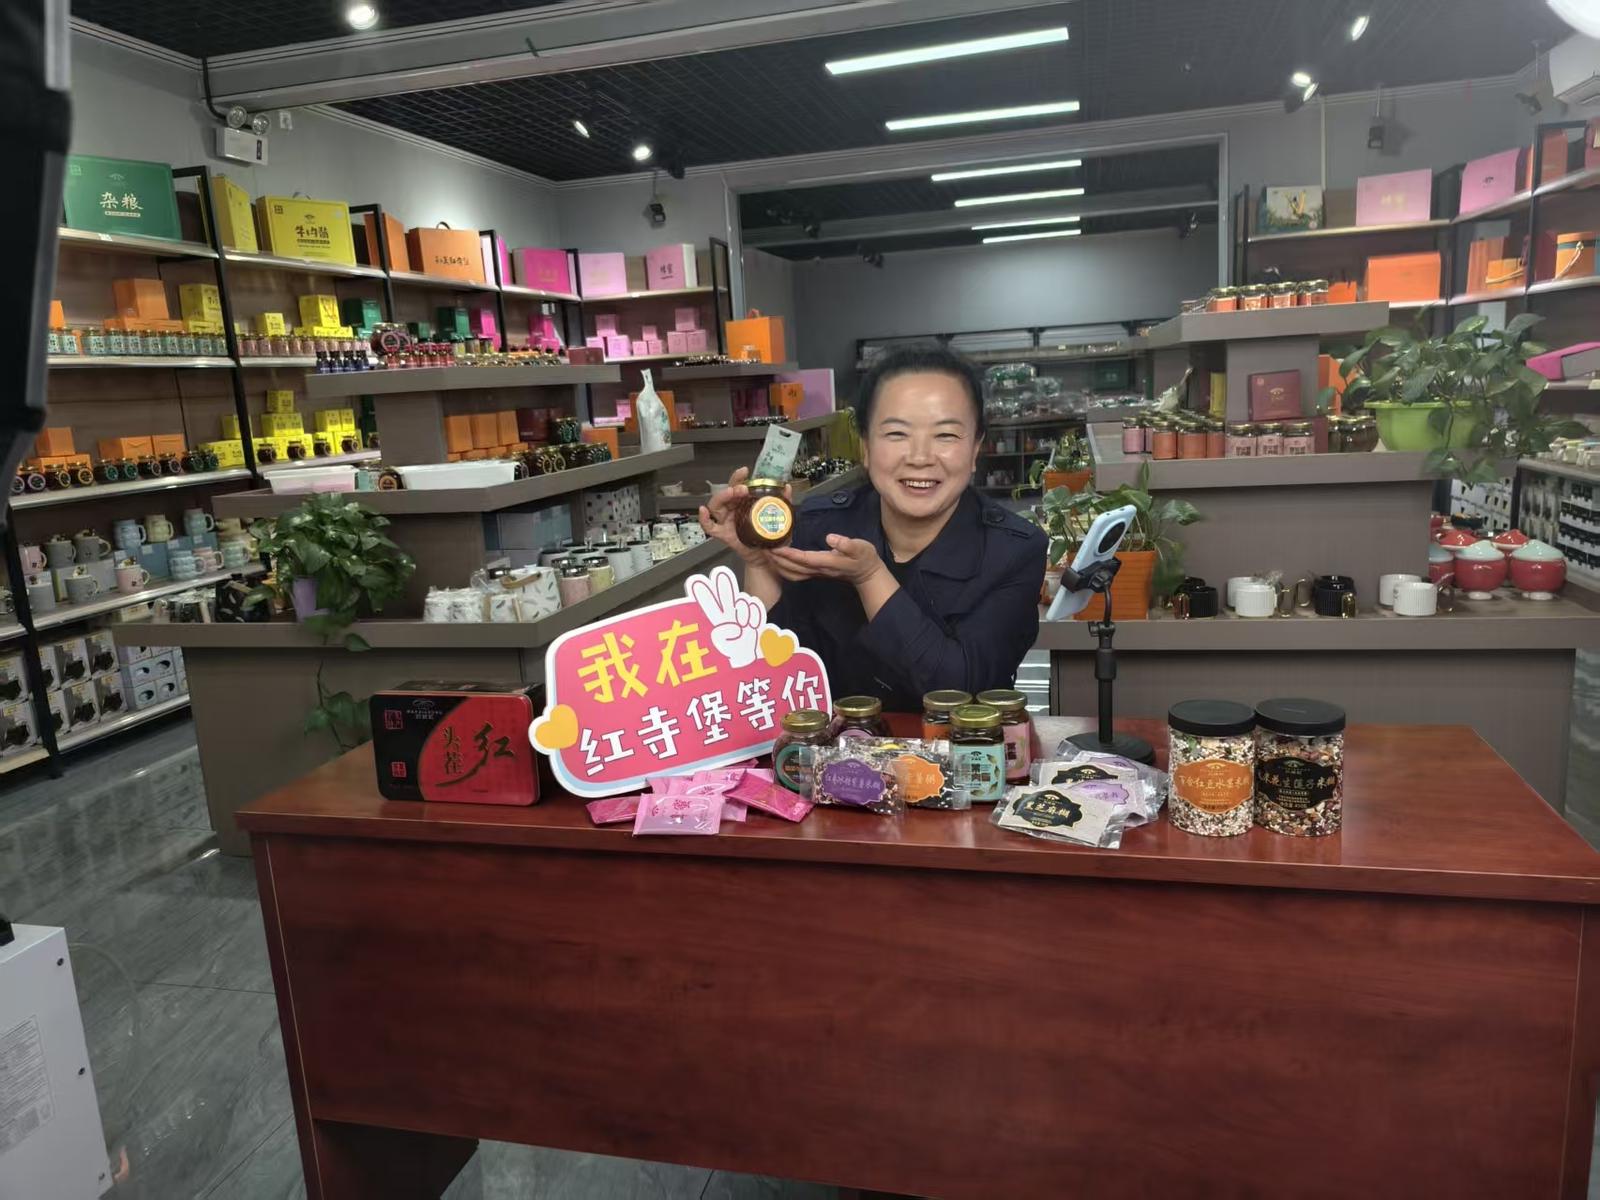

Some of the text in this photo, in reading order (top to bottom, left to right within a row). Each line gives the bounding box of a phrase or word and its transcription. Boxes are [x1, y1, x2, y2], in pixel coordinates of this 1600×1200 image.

[100, 192, 143, 210] 杂粮
[577, 620, 718, 703] 我在
[579, 670, 823, 777] 红寺堡等你
